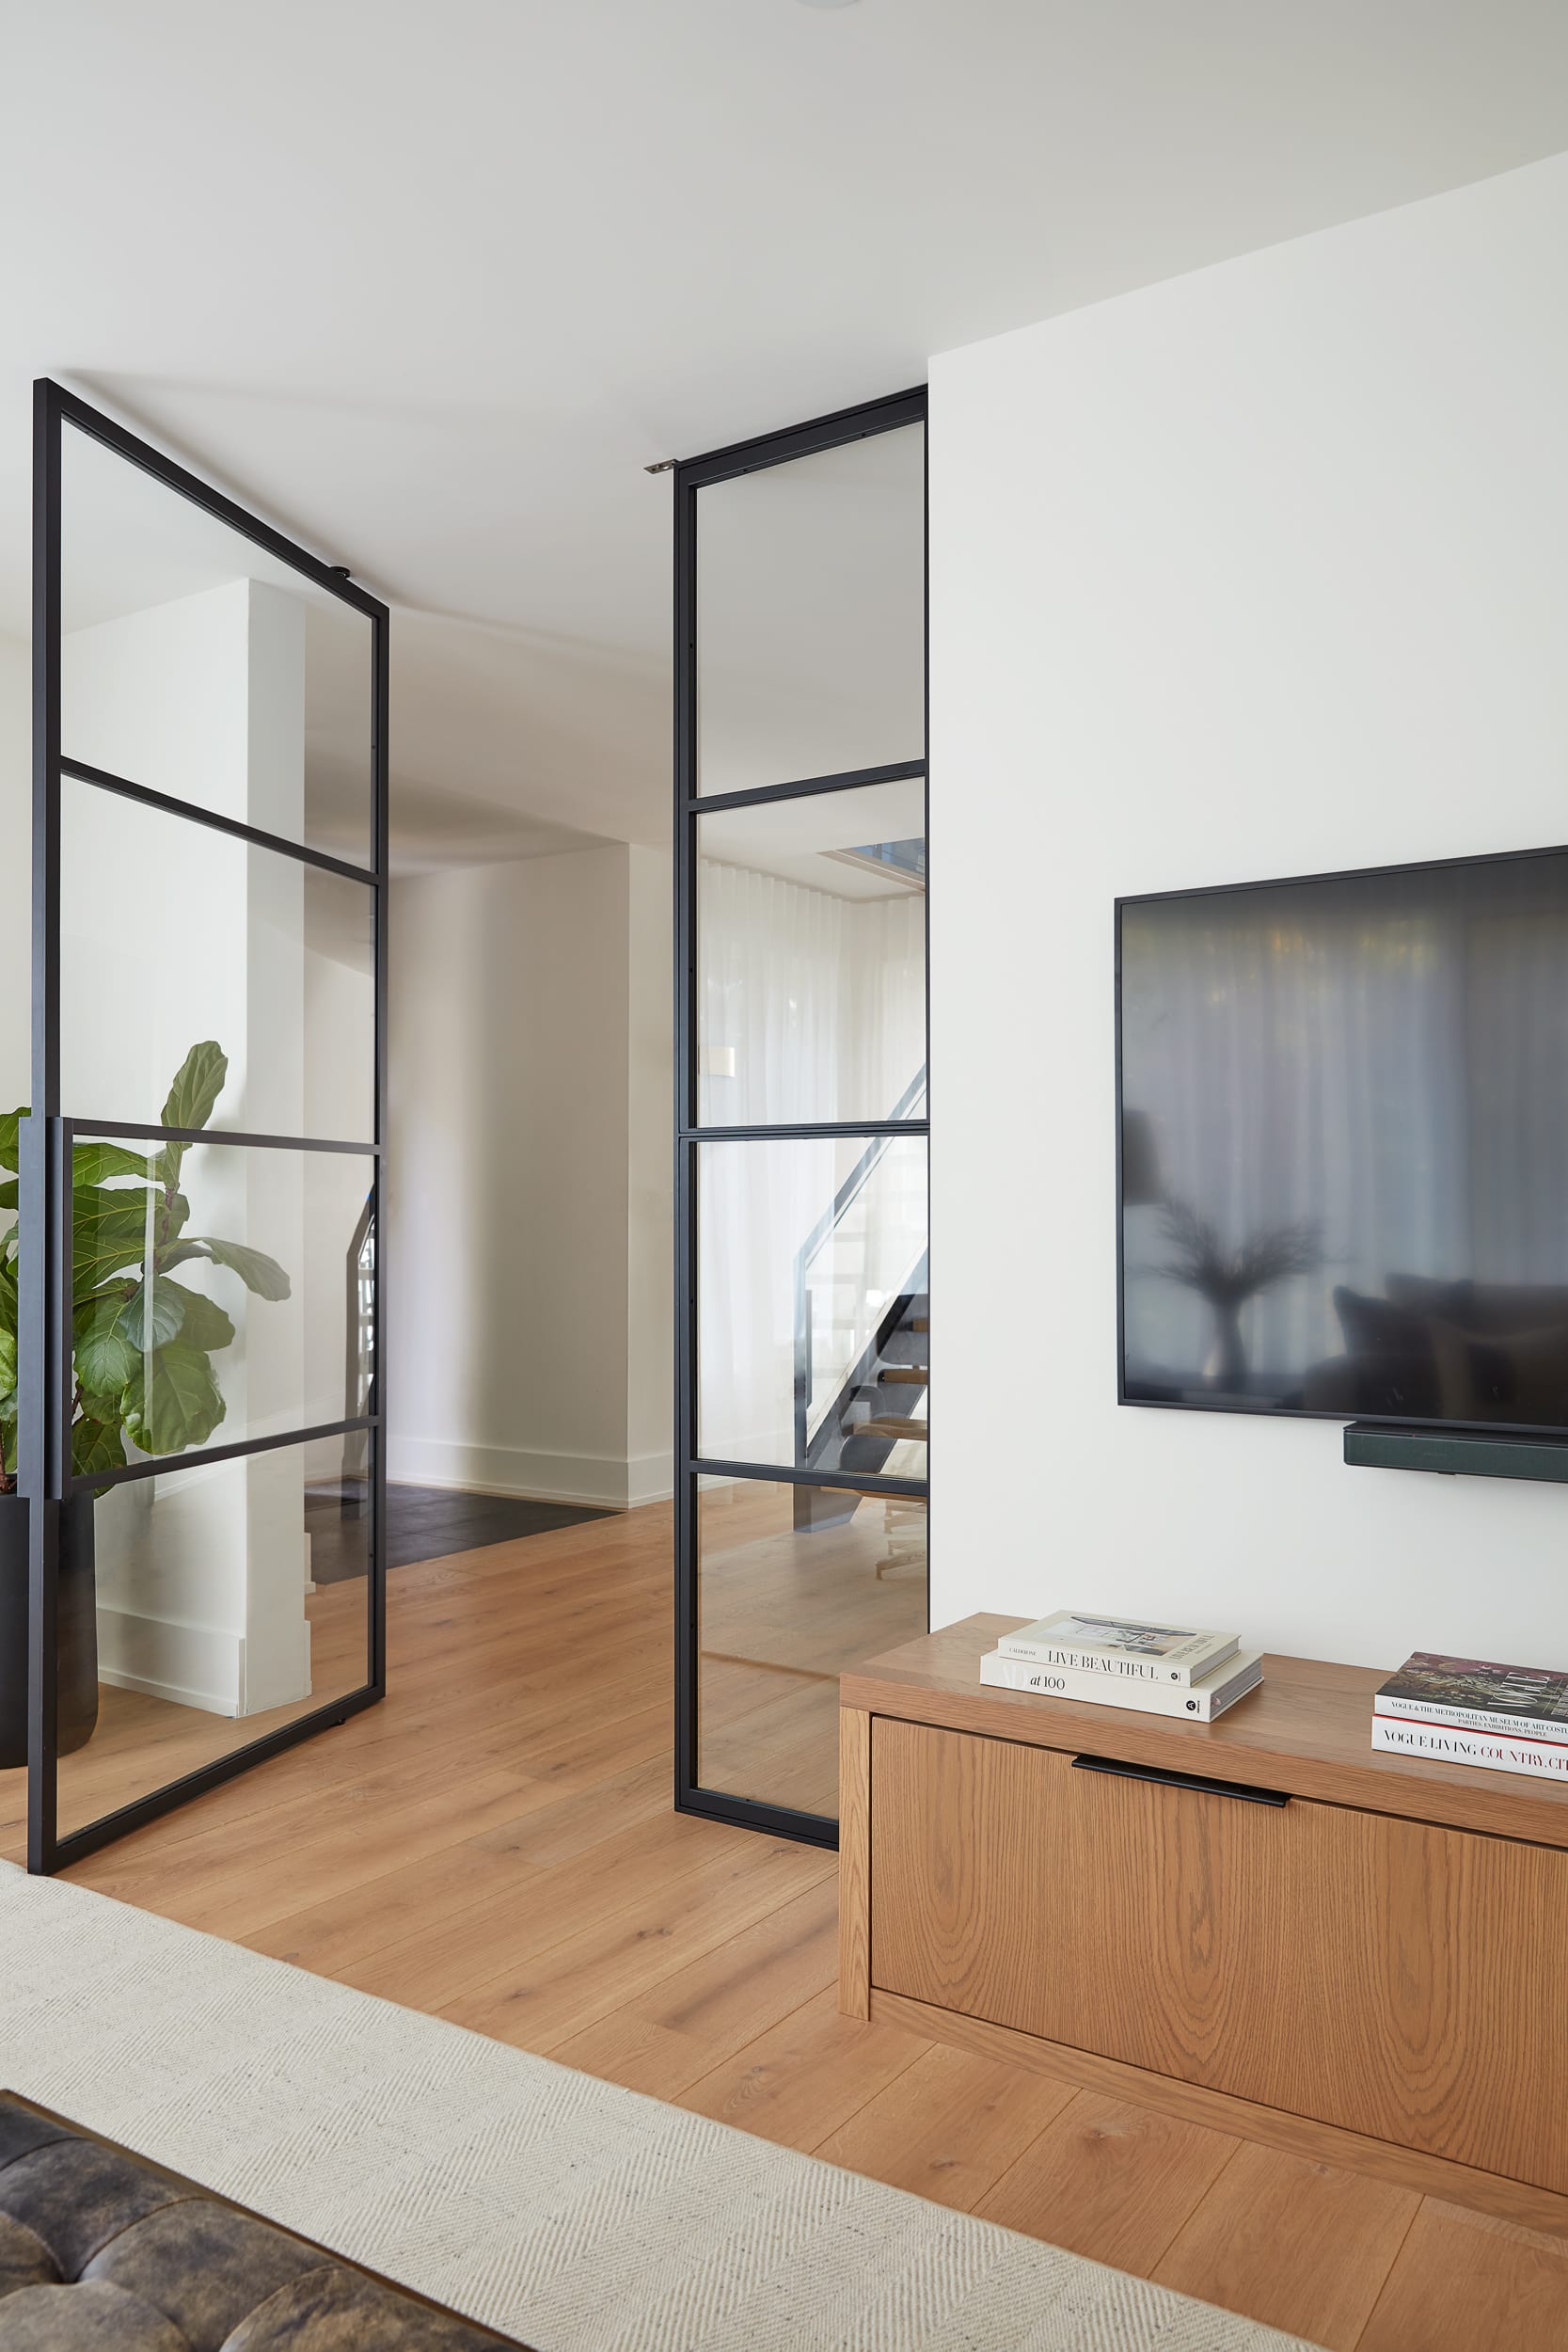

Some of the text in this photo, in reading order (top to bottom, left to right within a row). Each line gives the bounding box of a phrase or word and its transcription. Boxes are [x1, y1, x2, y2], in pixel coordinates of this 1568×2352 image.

[1048, 1650, 1078, 1666] LIVE
[1082, 1656, 1158, 1679] BEAUTIFUL
[1030, 1676, 1040, 1686] at
[1043, 1677, 1066, 1690] 100
[1487, 1672, 1550, 1708] VOGUE
[1420, 1706, 1433, 1714] THE
[1434, 1708, 1487, 1721] METROPOLITAN
[1489, 1716, 1520, 1727] MUSEUM
[1385, 1730, 1428, 1747] VOGUE
[1431, 1737, 1476, 1755] LIVING
[1524, 1728, 1546, 1737] PEOPLE
